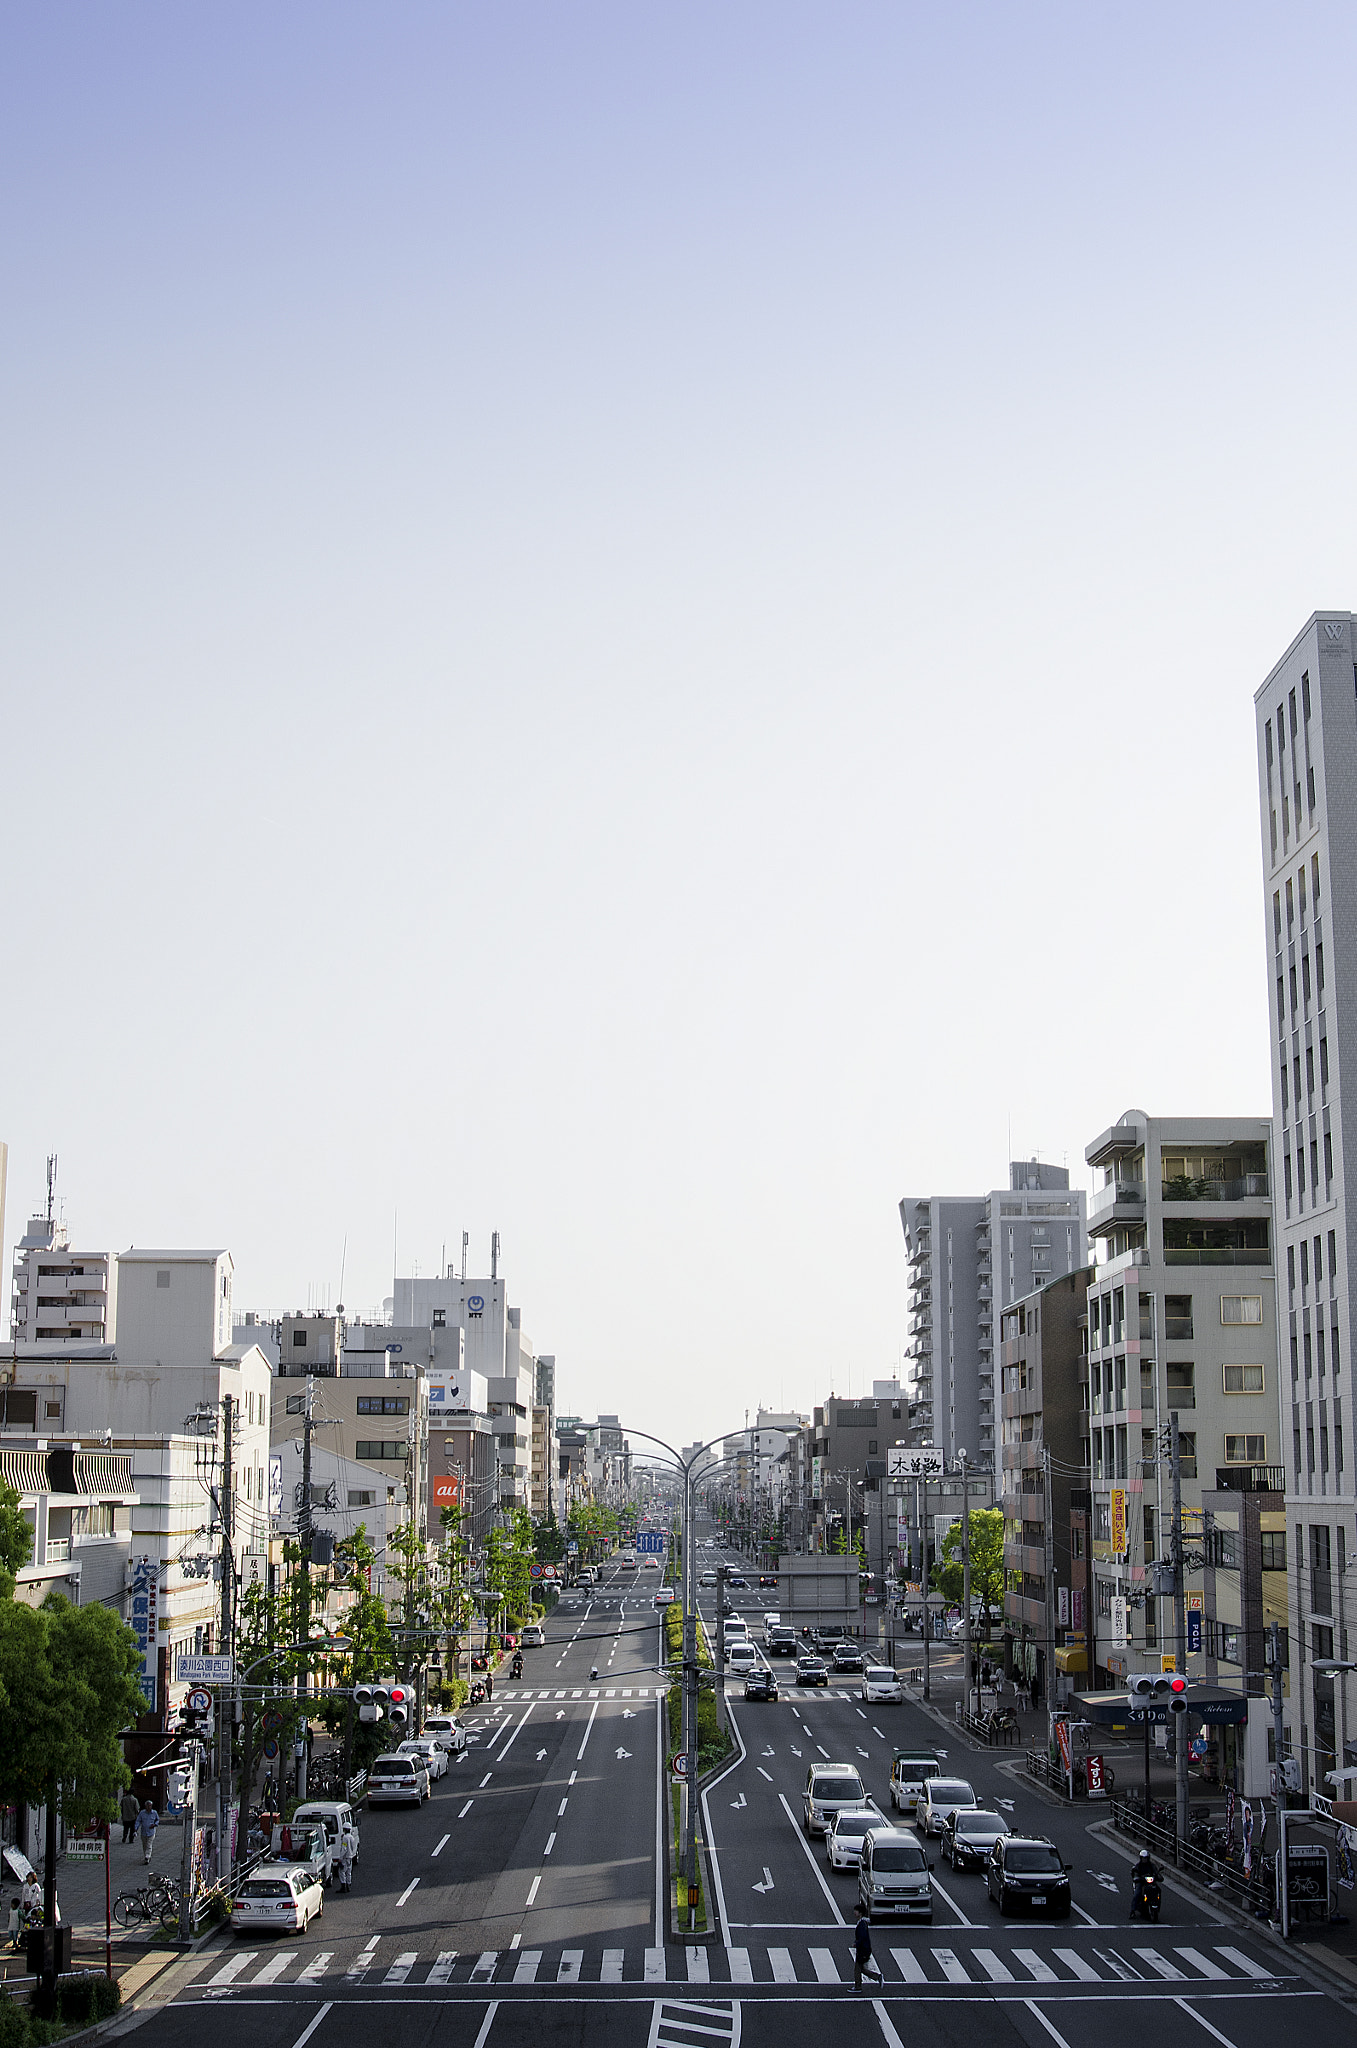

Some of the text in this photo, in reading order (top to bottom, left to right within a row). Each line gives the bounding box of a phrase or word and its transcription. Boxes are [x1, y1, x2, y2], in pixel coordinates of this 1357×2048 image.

[890, 1457, 941, 1474] 木曽路
[1192, 1624, 1200, 1649] POLA
[180, 1659, 230, 1671] 湊川公園西口
[1090, 1756, 1101, 1789] くすり
[70, 1842, 102, 1851] 川崎病院
